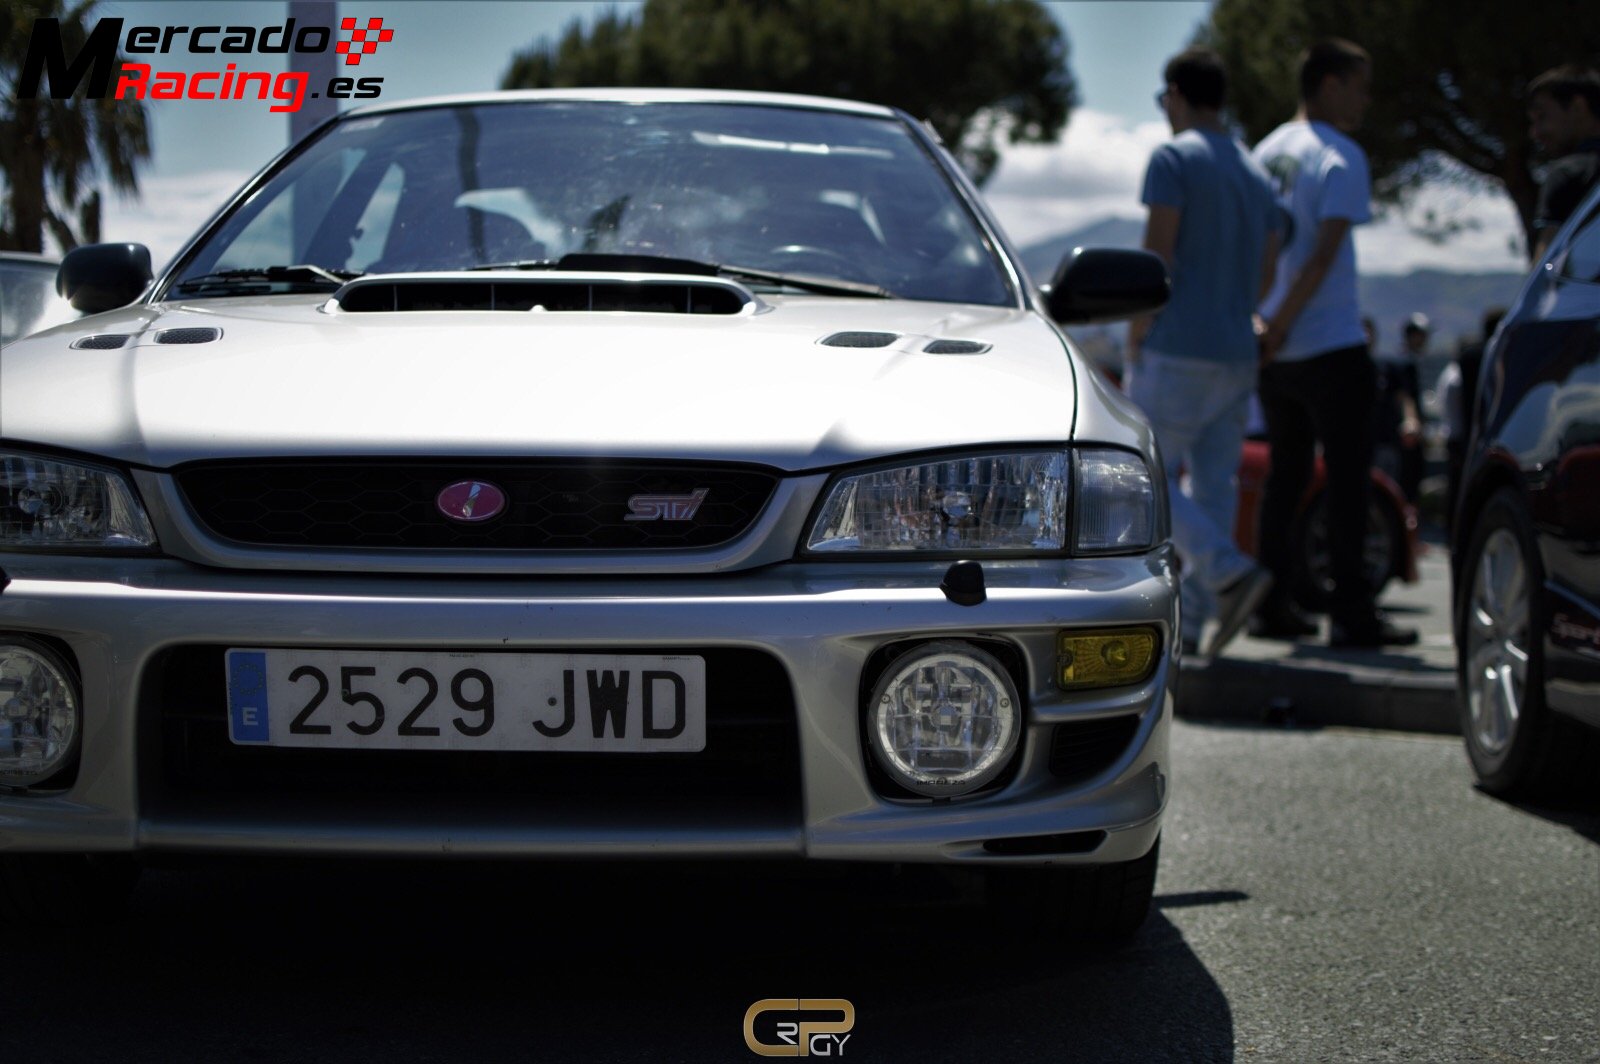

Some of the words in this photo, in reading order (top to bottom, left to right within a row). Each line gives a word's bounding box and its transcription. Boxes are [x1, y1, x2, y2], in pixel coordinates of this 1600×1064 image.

[242, 707, 259, 726] E
[287, 665, 495, 737] 2529
[532, 669, 686, 740] JWD
